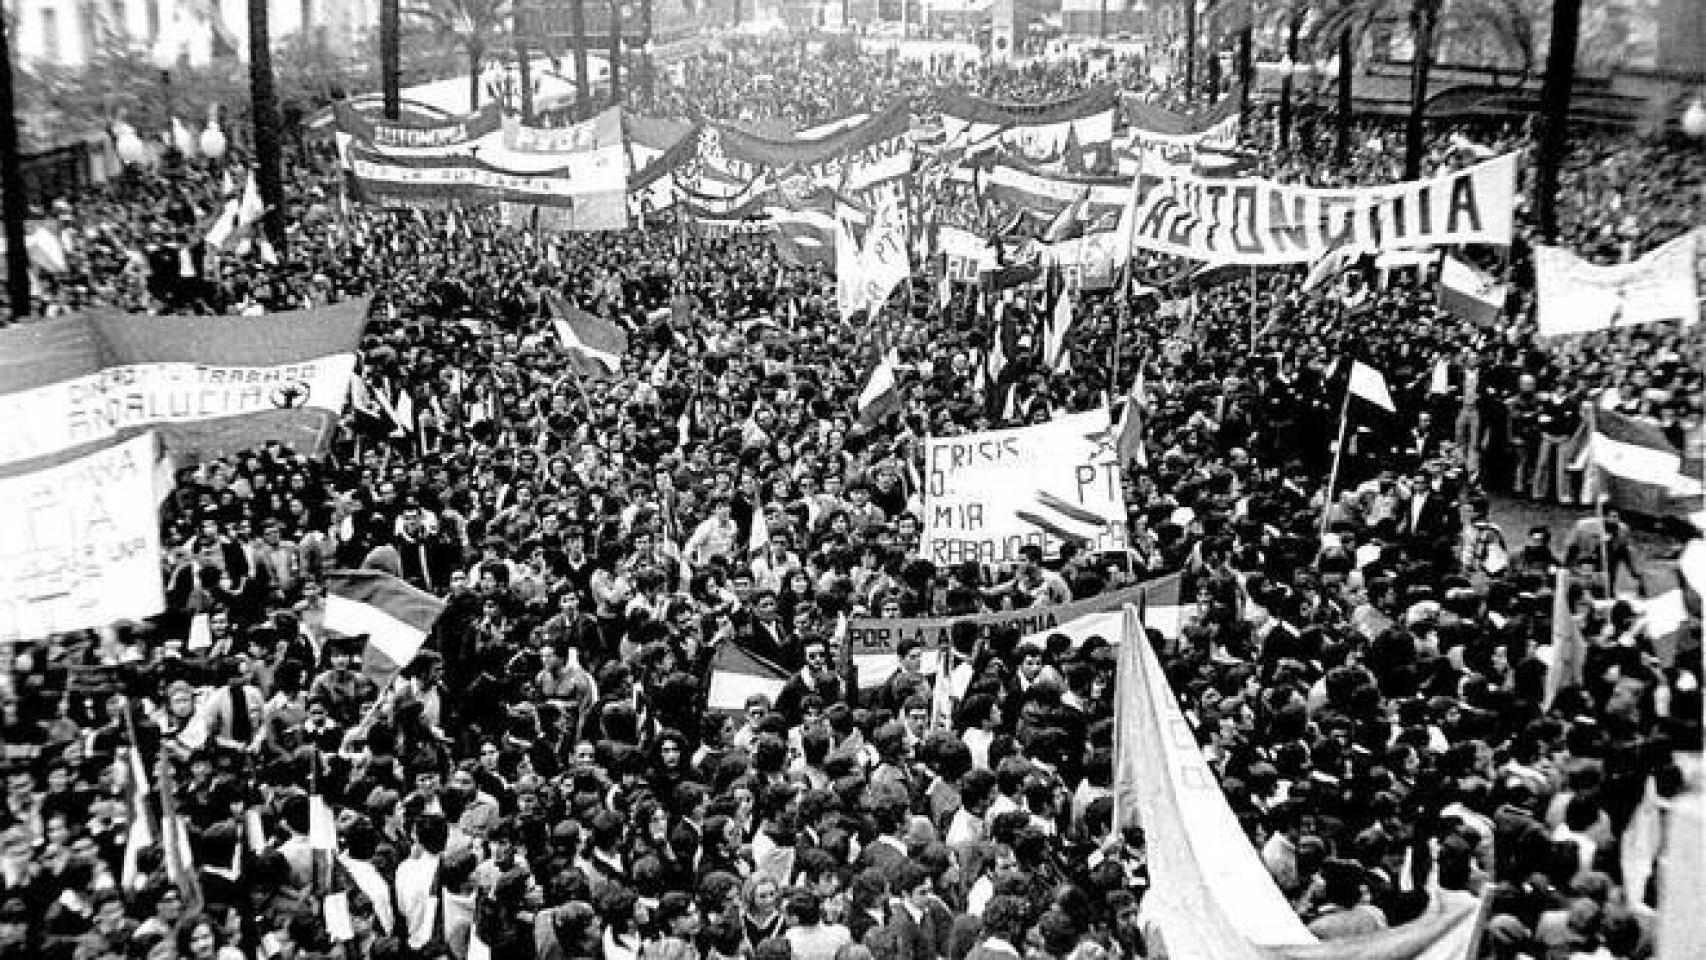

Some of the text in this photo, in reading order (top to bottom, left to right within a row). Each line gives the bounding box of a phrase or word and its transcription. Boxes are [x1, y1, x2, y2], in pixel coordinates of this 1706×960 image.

[1138, 172, 1484, 255] AUTONOMIA
[67, 386, 262, 438] ANDALUCIA
[932, 437, 1020, 472] CRISIS
[1075, 460, 1122, 504] PT
[932, 504, 982, 531] MIA
[852, 628, 891, 648] POR
